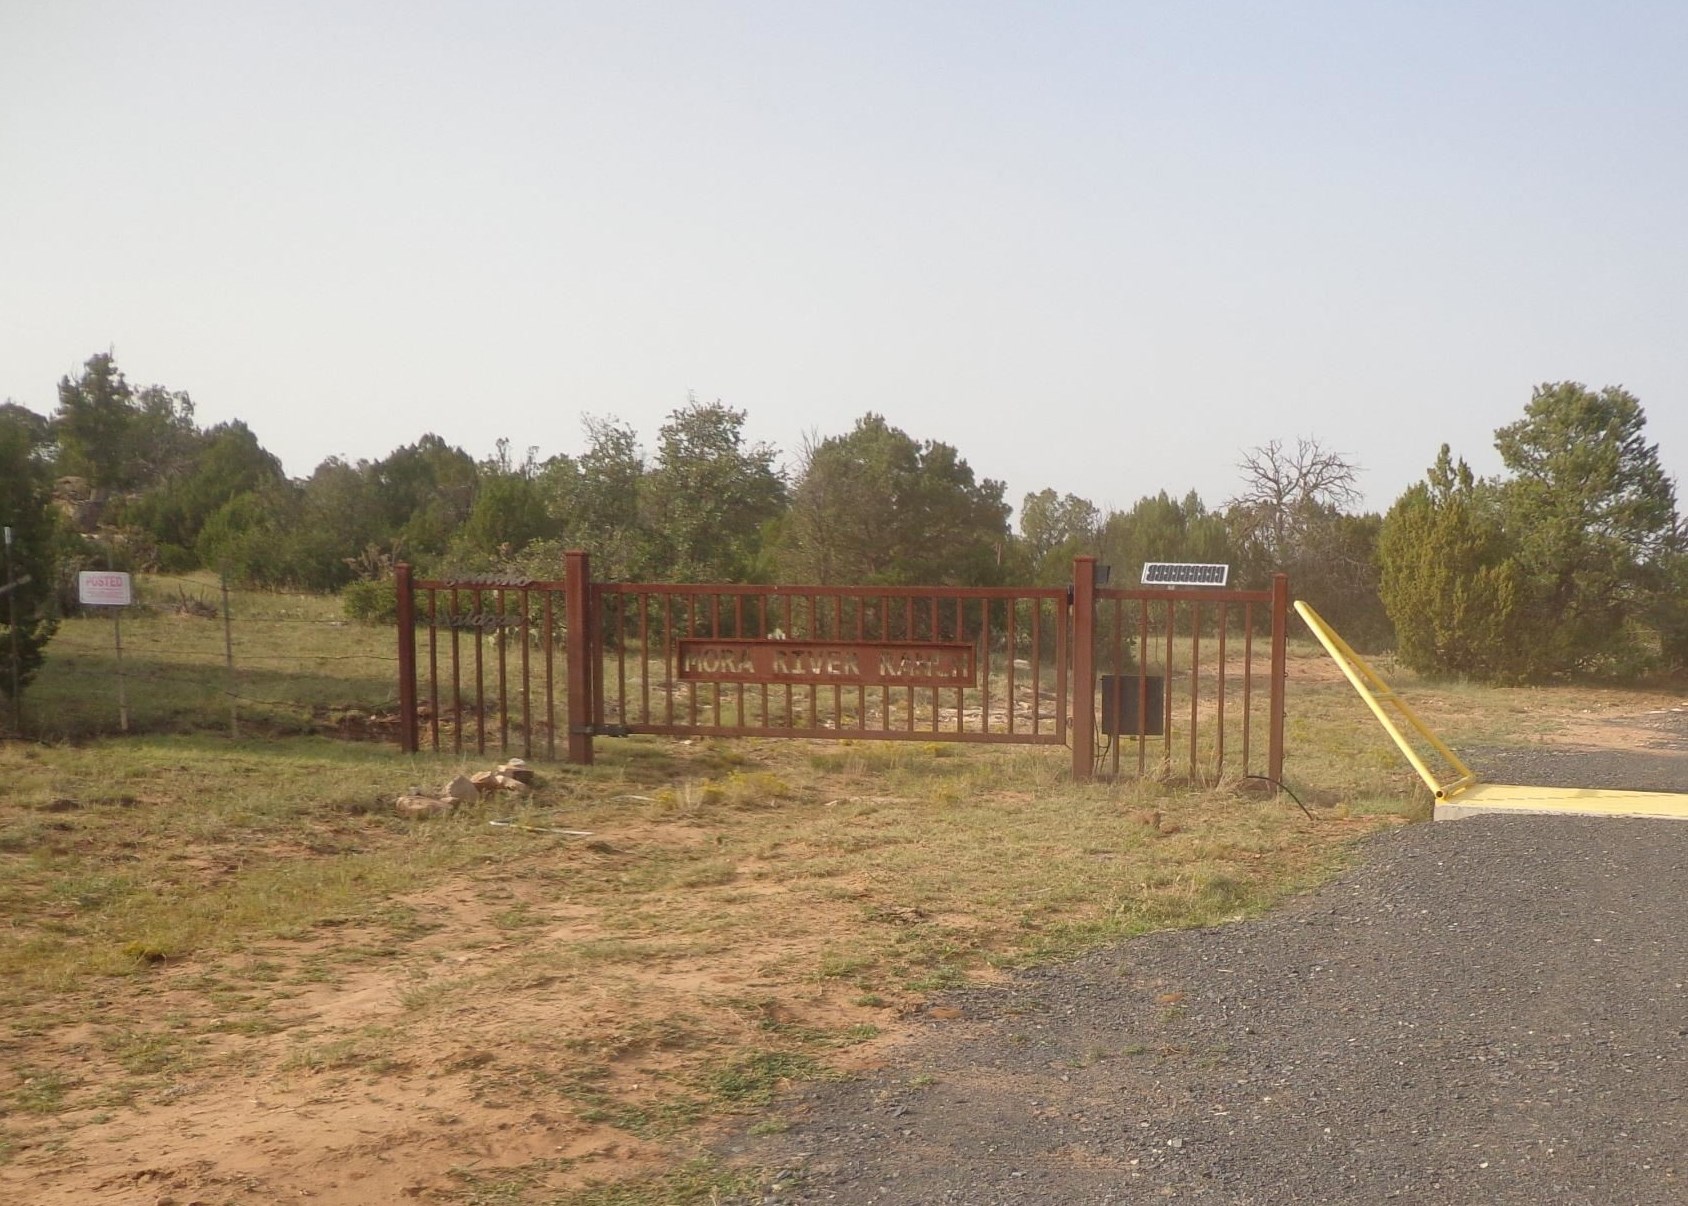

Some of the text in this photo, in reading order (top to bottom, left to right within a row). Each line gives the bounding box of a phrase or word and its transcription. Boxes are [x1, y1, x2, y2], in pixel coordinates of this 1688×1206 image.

[86, 575, 123, 587] POSTED
[684, 649, 755, 673] MORA
[773, 650, 860, 676] RIVER
